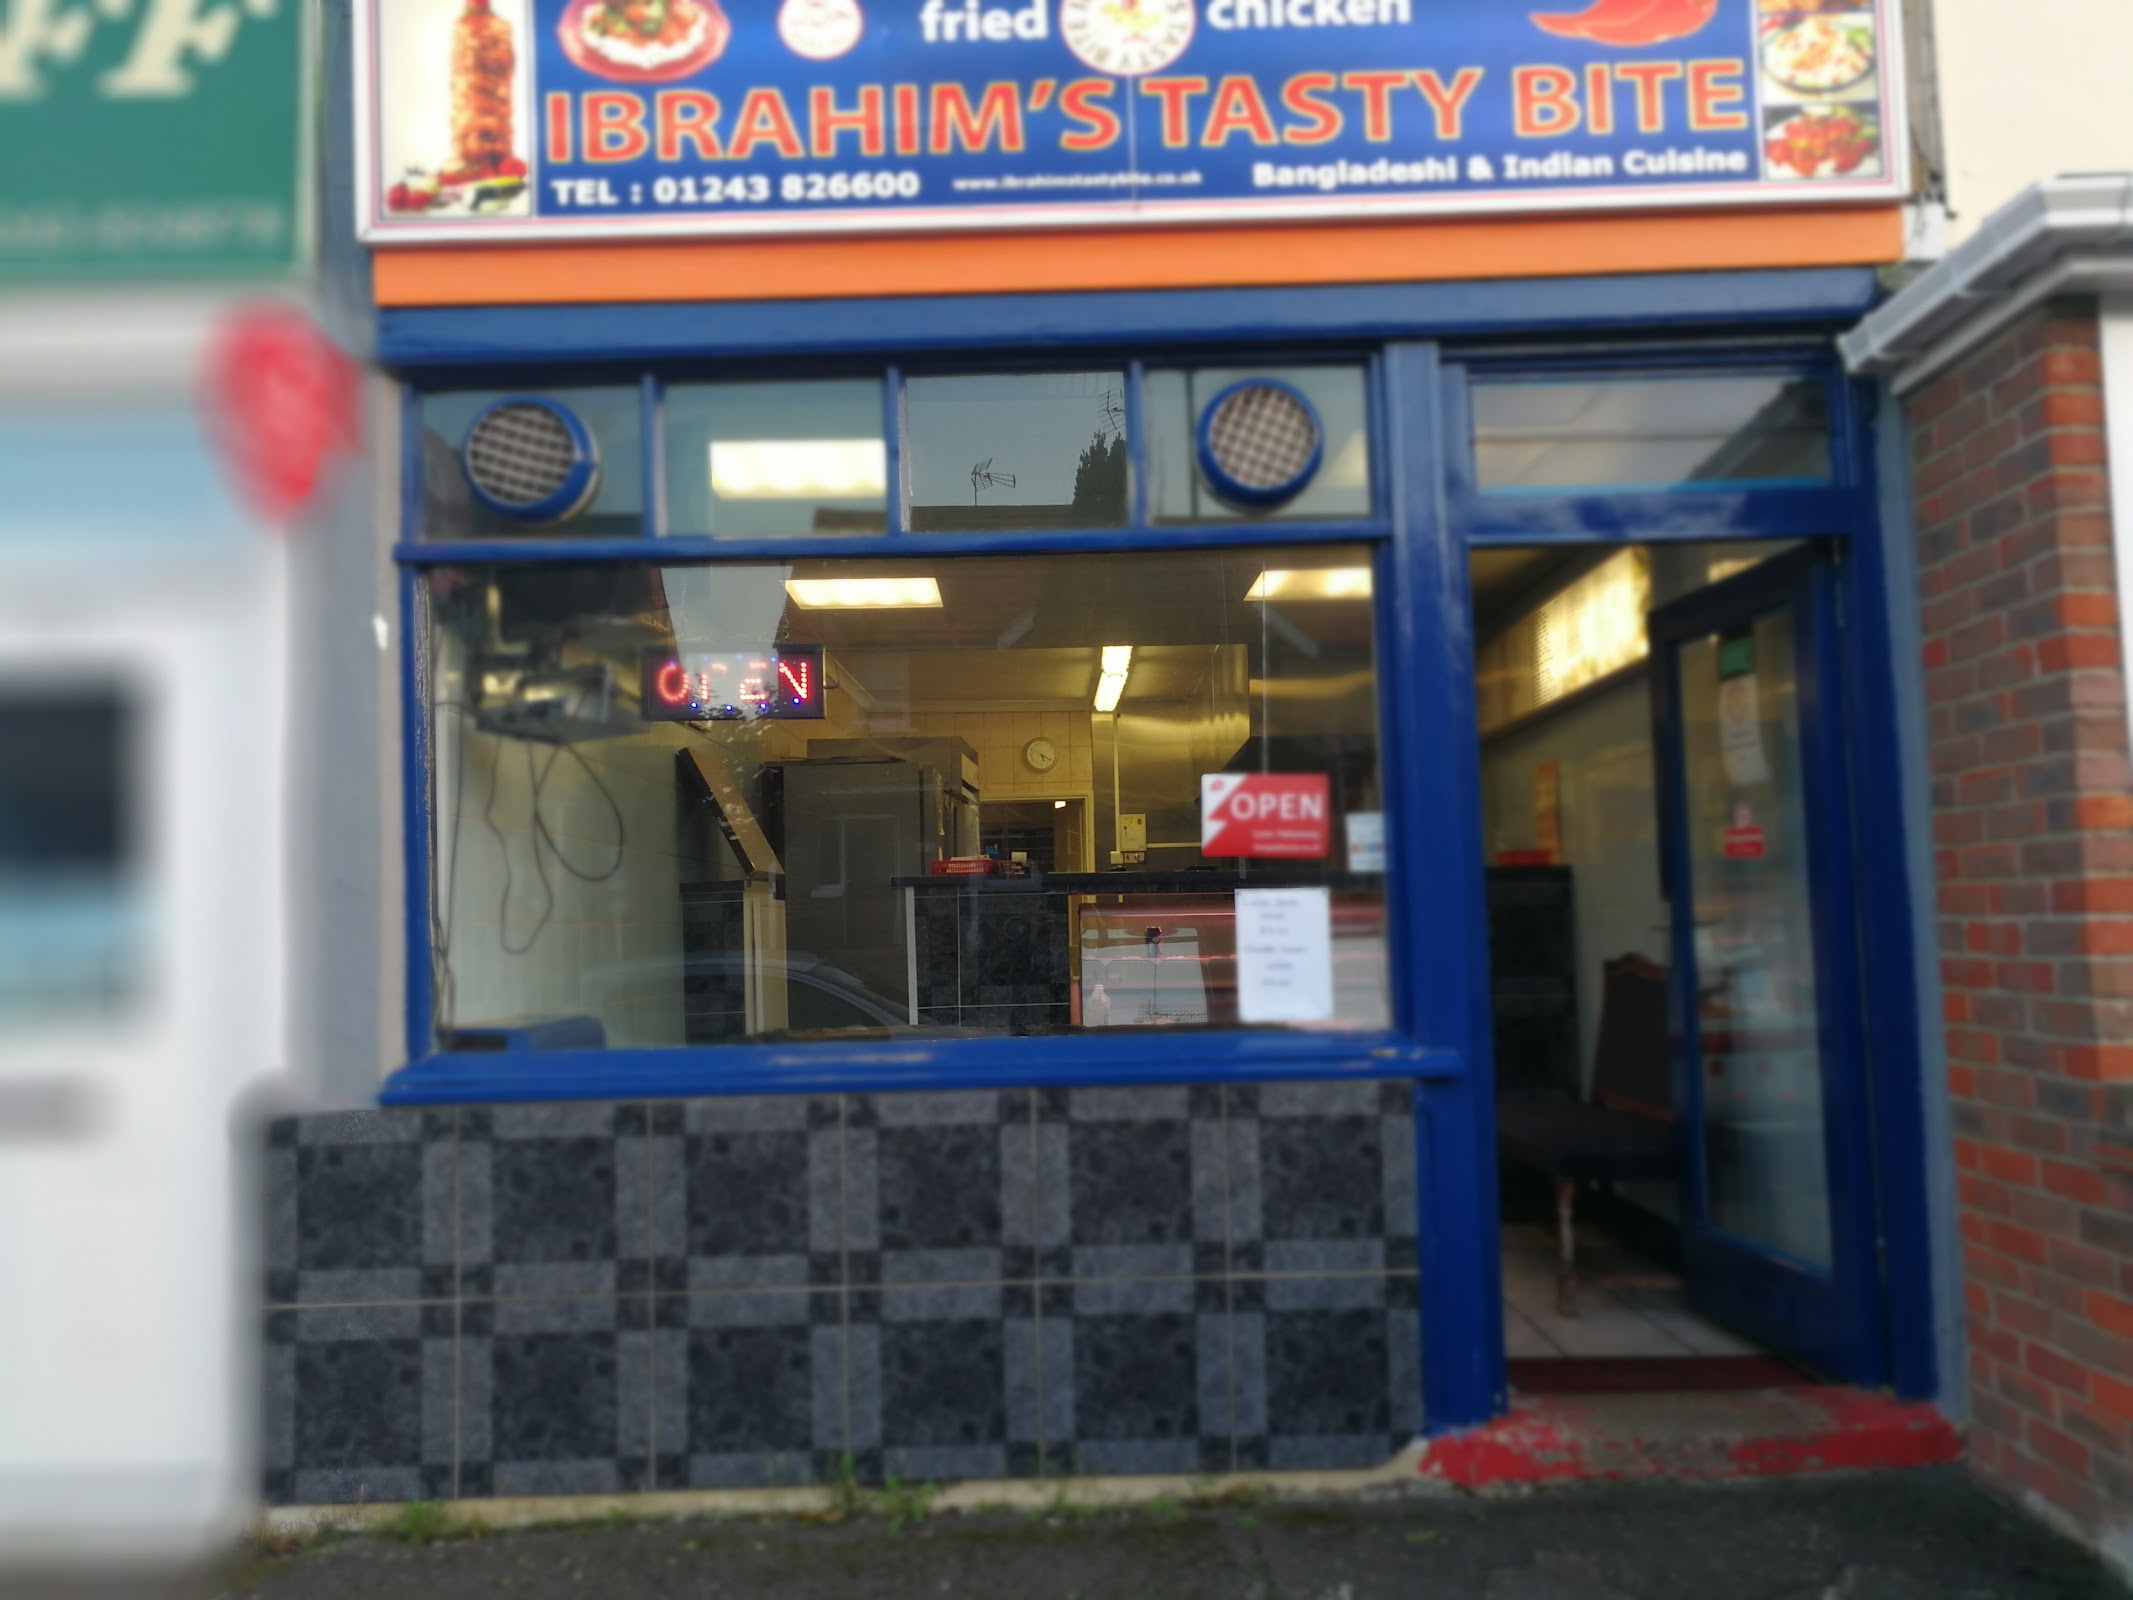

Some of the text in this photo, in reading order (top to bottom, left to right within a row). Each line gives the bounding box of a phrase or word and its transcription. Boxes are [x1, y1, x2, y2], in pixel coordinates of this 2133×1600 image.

[920, 0, 1411, 42] fried chicken
[546, 60, 1748, 163] IBRAHIM’S TASTY BITE
[551, 179, 618, 206] TEL
[653, 176, 770, 204] 01243
[781, 171, 920, 200] 826600
[1252, 149, 1748, 189] Bangladeshi & Indian Cuisine
[1230, 793, 1322, 820] OPEN
